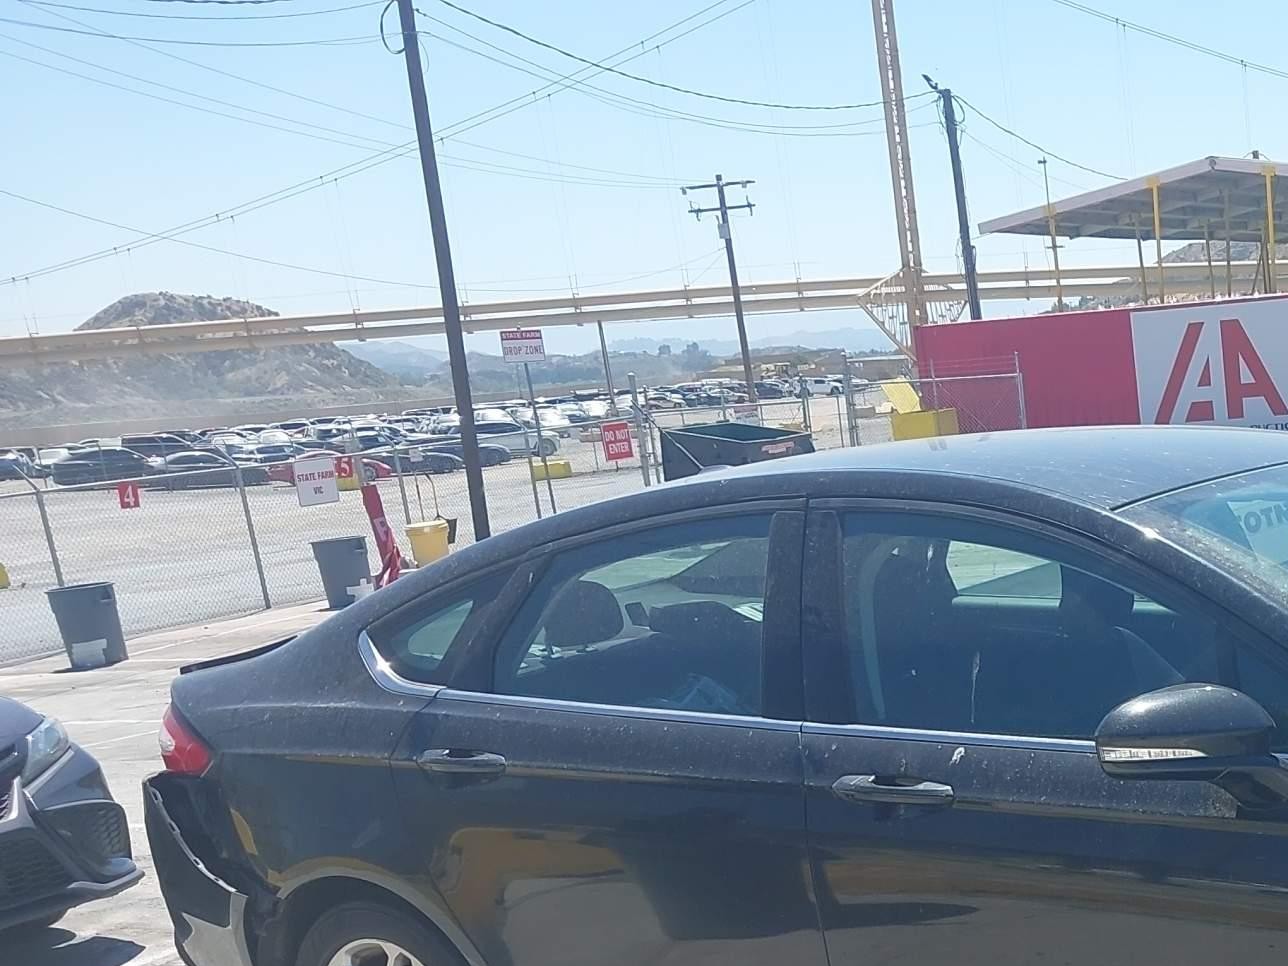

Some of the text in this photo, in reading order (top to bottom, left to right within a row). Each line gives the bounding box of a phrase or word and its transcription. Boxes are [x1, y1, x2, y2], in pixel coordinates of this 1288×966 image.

[504, 345, 543, 355] DROP ZONE
[604, 429, 629, 441] DO NOT
[608, 442, 630, 454] ENTER
[297, 470, 334, 482] STATE FARM
[124, 485, 135, 506] 4
